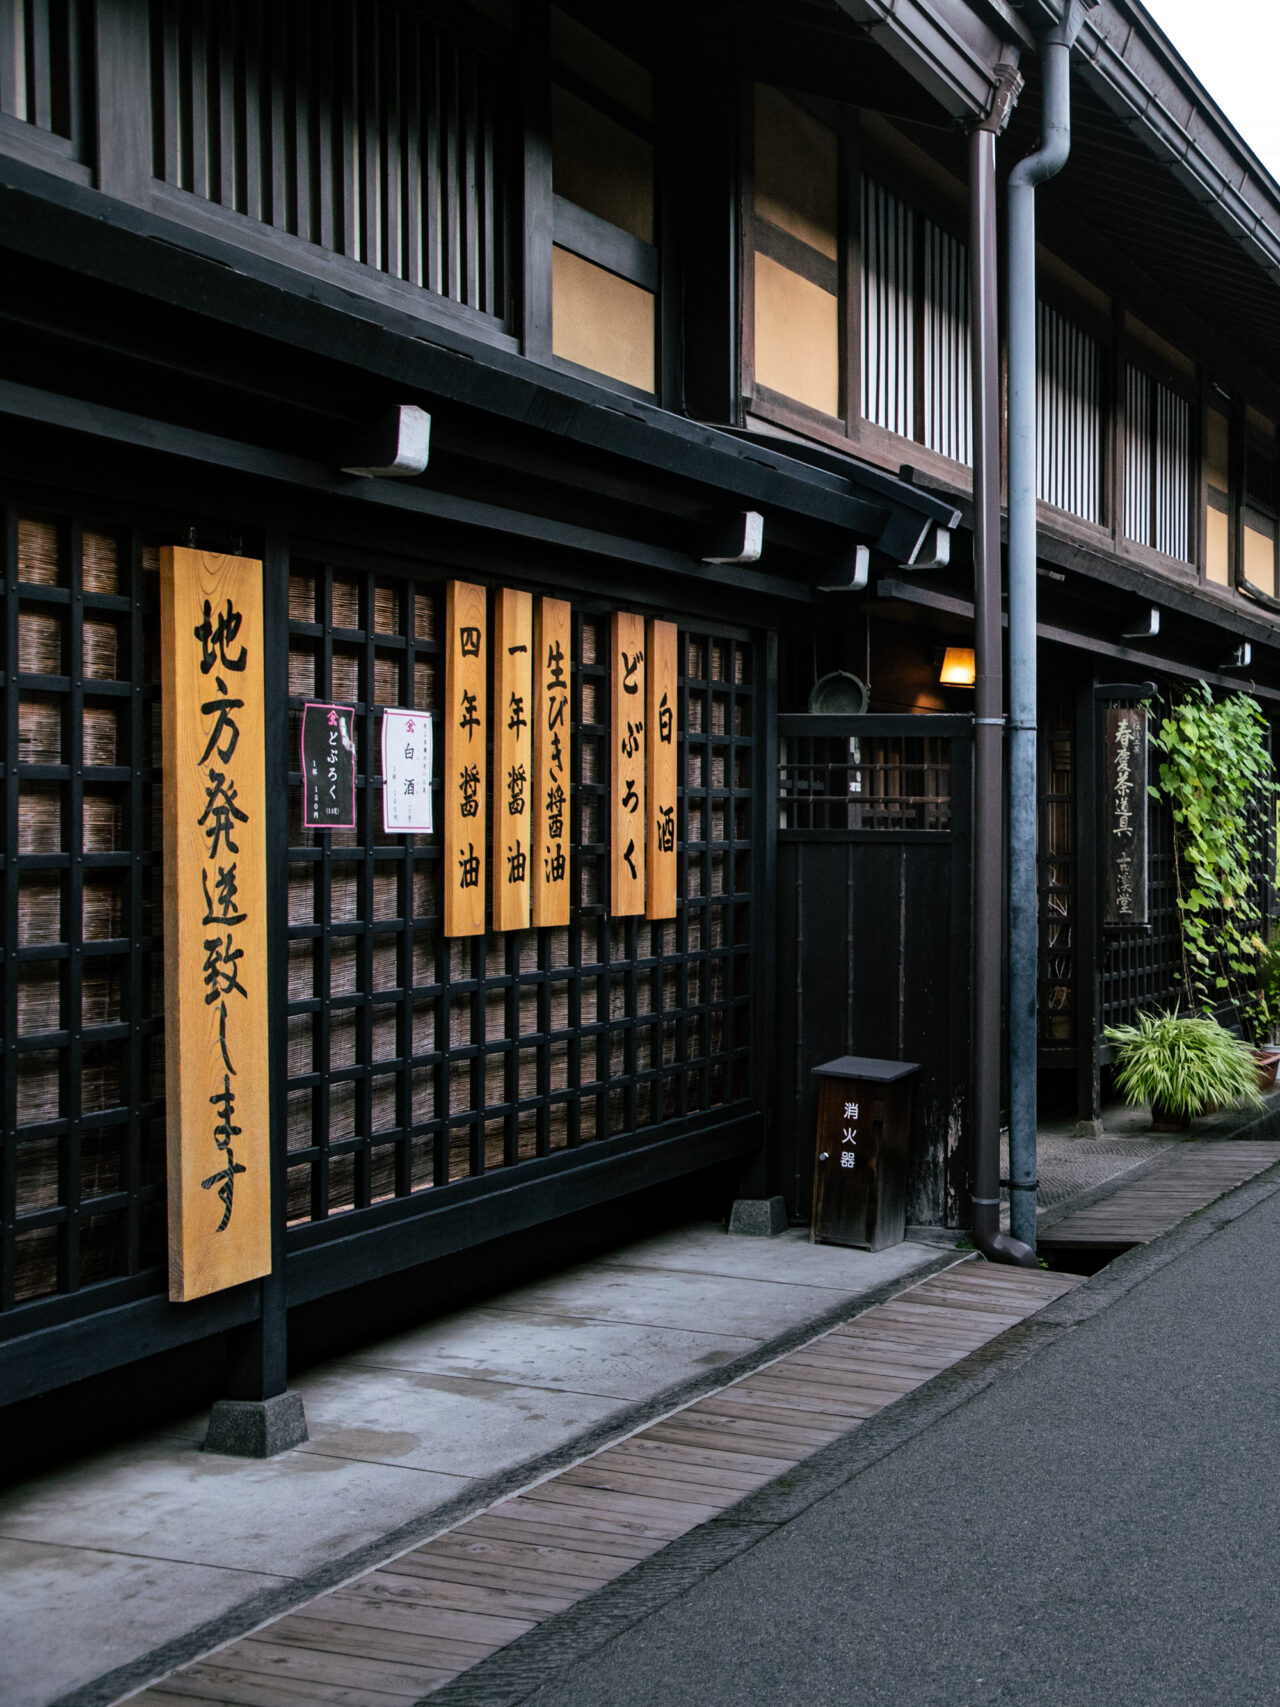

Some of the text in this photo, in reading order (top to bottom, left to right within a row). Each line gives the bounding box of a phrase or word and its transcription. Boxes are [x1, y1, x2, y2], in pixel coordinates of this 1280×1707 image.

[404, 742, 415, 796] 白酒
[459, 627, 481, 888] 四年醤油
[507, 645, 527, 884] 一年醤油
[545, 640, 568, 883] 生びき醤油
[621, 651, 643, 880] どぶろく
[1113, 719, 1134, 837] 春慶茶道具
[194, 599, 249, 1232] 地方発送致します
[840, 1102, 859, 1168] 消火器
